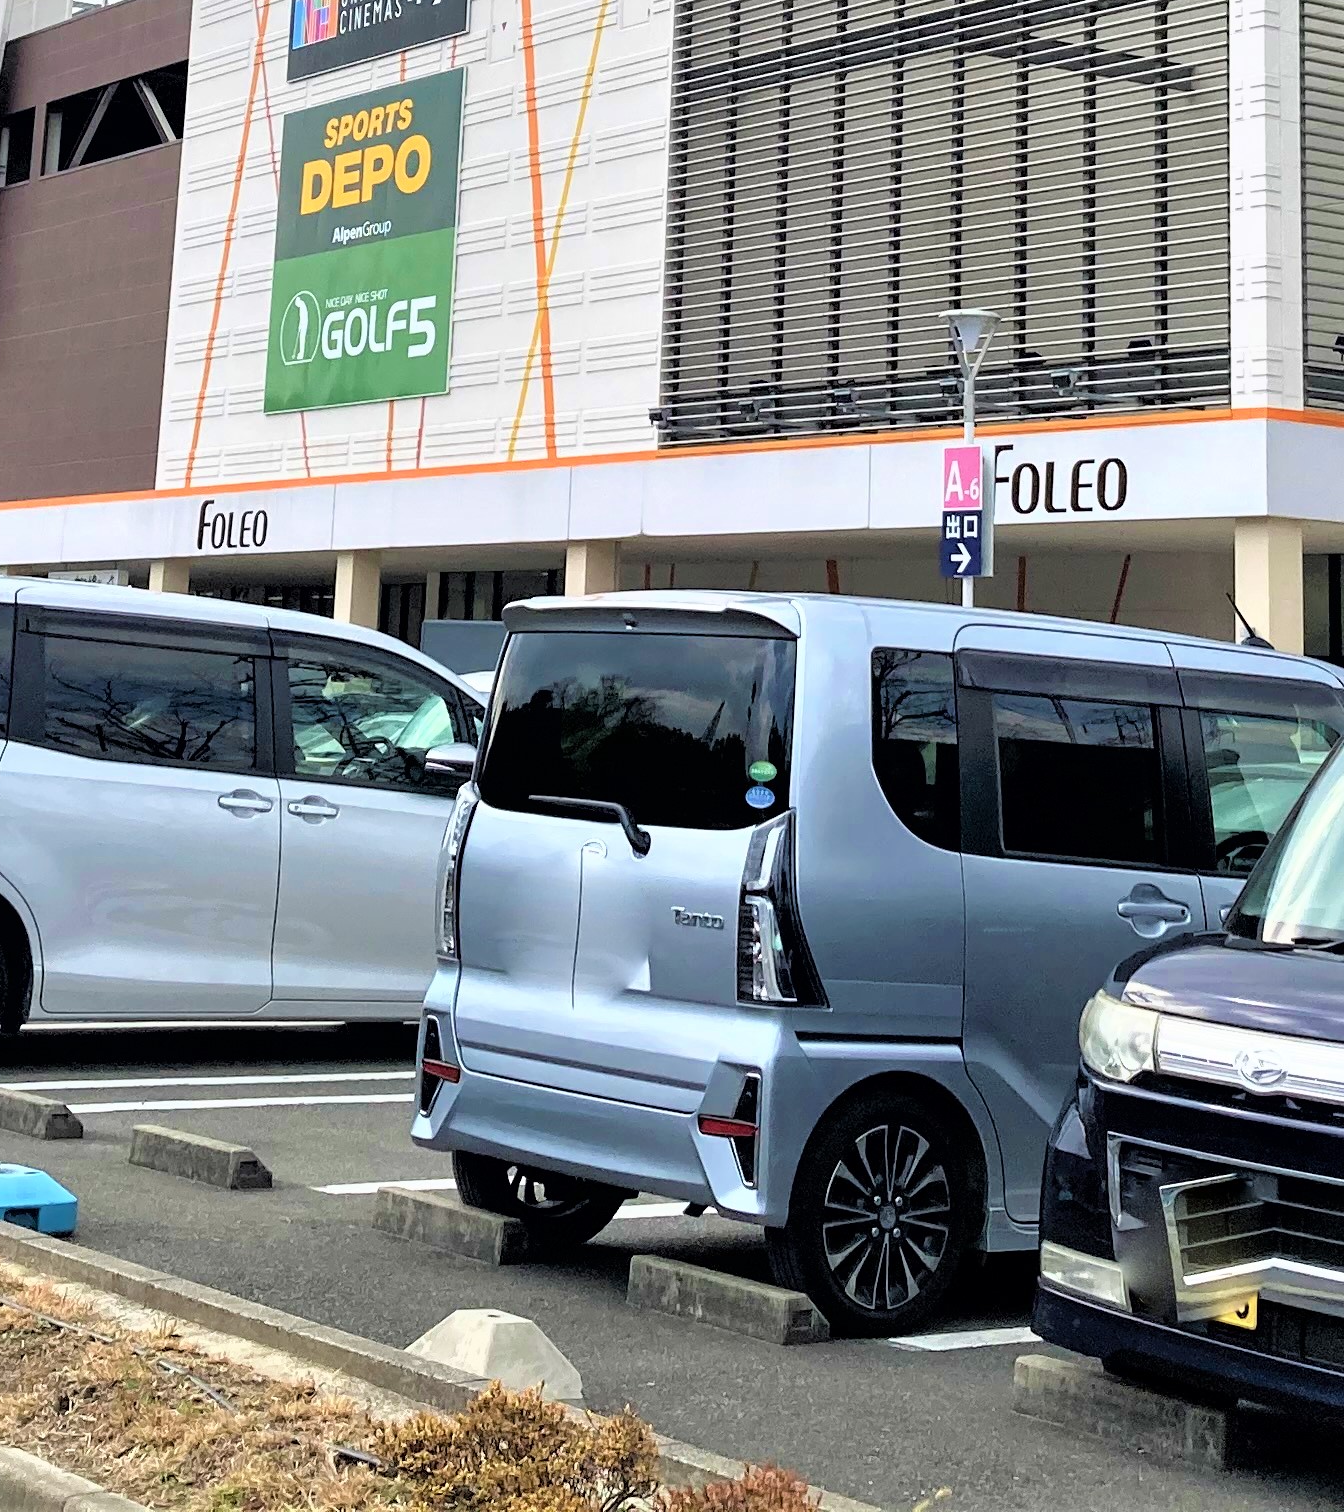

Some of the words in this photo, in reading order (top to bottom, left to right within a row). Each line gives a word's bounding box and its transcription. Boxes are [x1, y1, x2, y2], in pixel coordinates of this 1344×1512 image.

[324, 98, 414, 149] SPORTS
[300, 134, 432, 216] DEPO
[326, 296, 340, 308] NICE
[355, 292, 369, 303] NICE
[945, 461, 979, 502] A-6
[197, 500, 268, 550] FOLEO
[945, 514, 978, 539] 出口
[670, 906, 725, 930] Tanto
